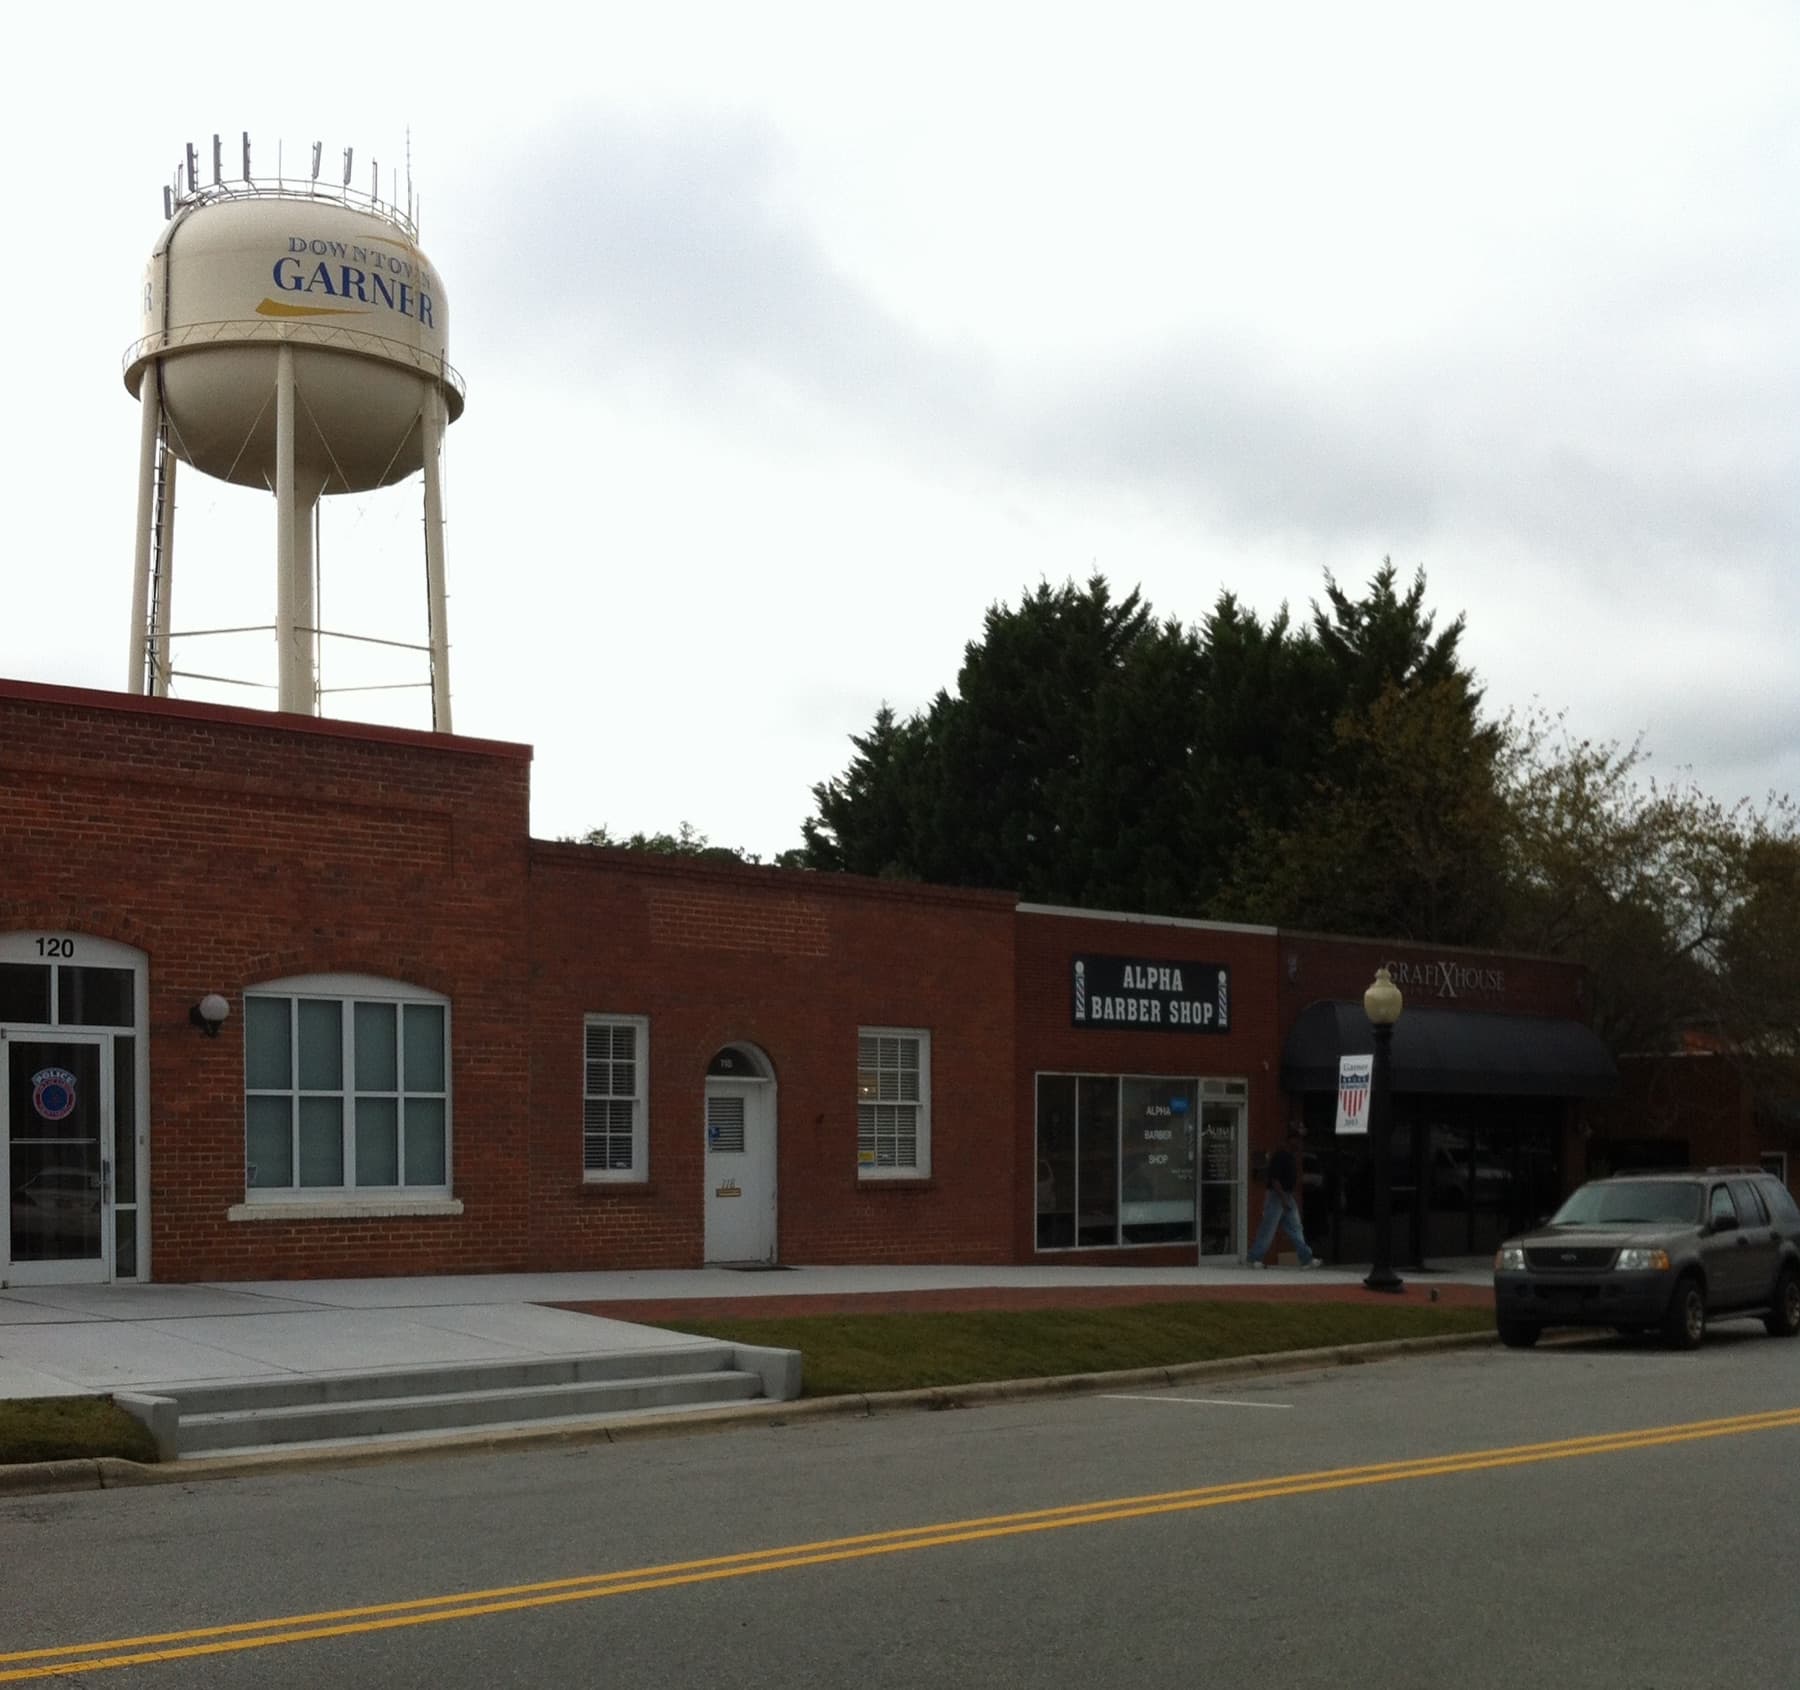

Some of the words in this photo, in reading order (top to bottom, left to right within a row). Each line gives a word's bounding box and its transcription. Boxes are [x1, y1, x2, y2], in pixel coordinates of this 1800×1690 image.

[272, 256, 433, 328] GARNER
[35, 937, 74, 958] 120
[1123, 965, 1183, 992] ALPHA
[1091, 996, 1161, 1022] BARBER
[1169, 1000, 1213, 1024] SHOP
[34, 1070, 73, 1084] POLICE
[1146, 1105, 1171, 1116] ALPHA
[1148, 1154, 1168, 1165] SHOP
